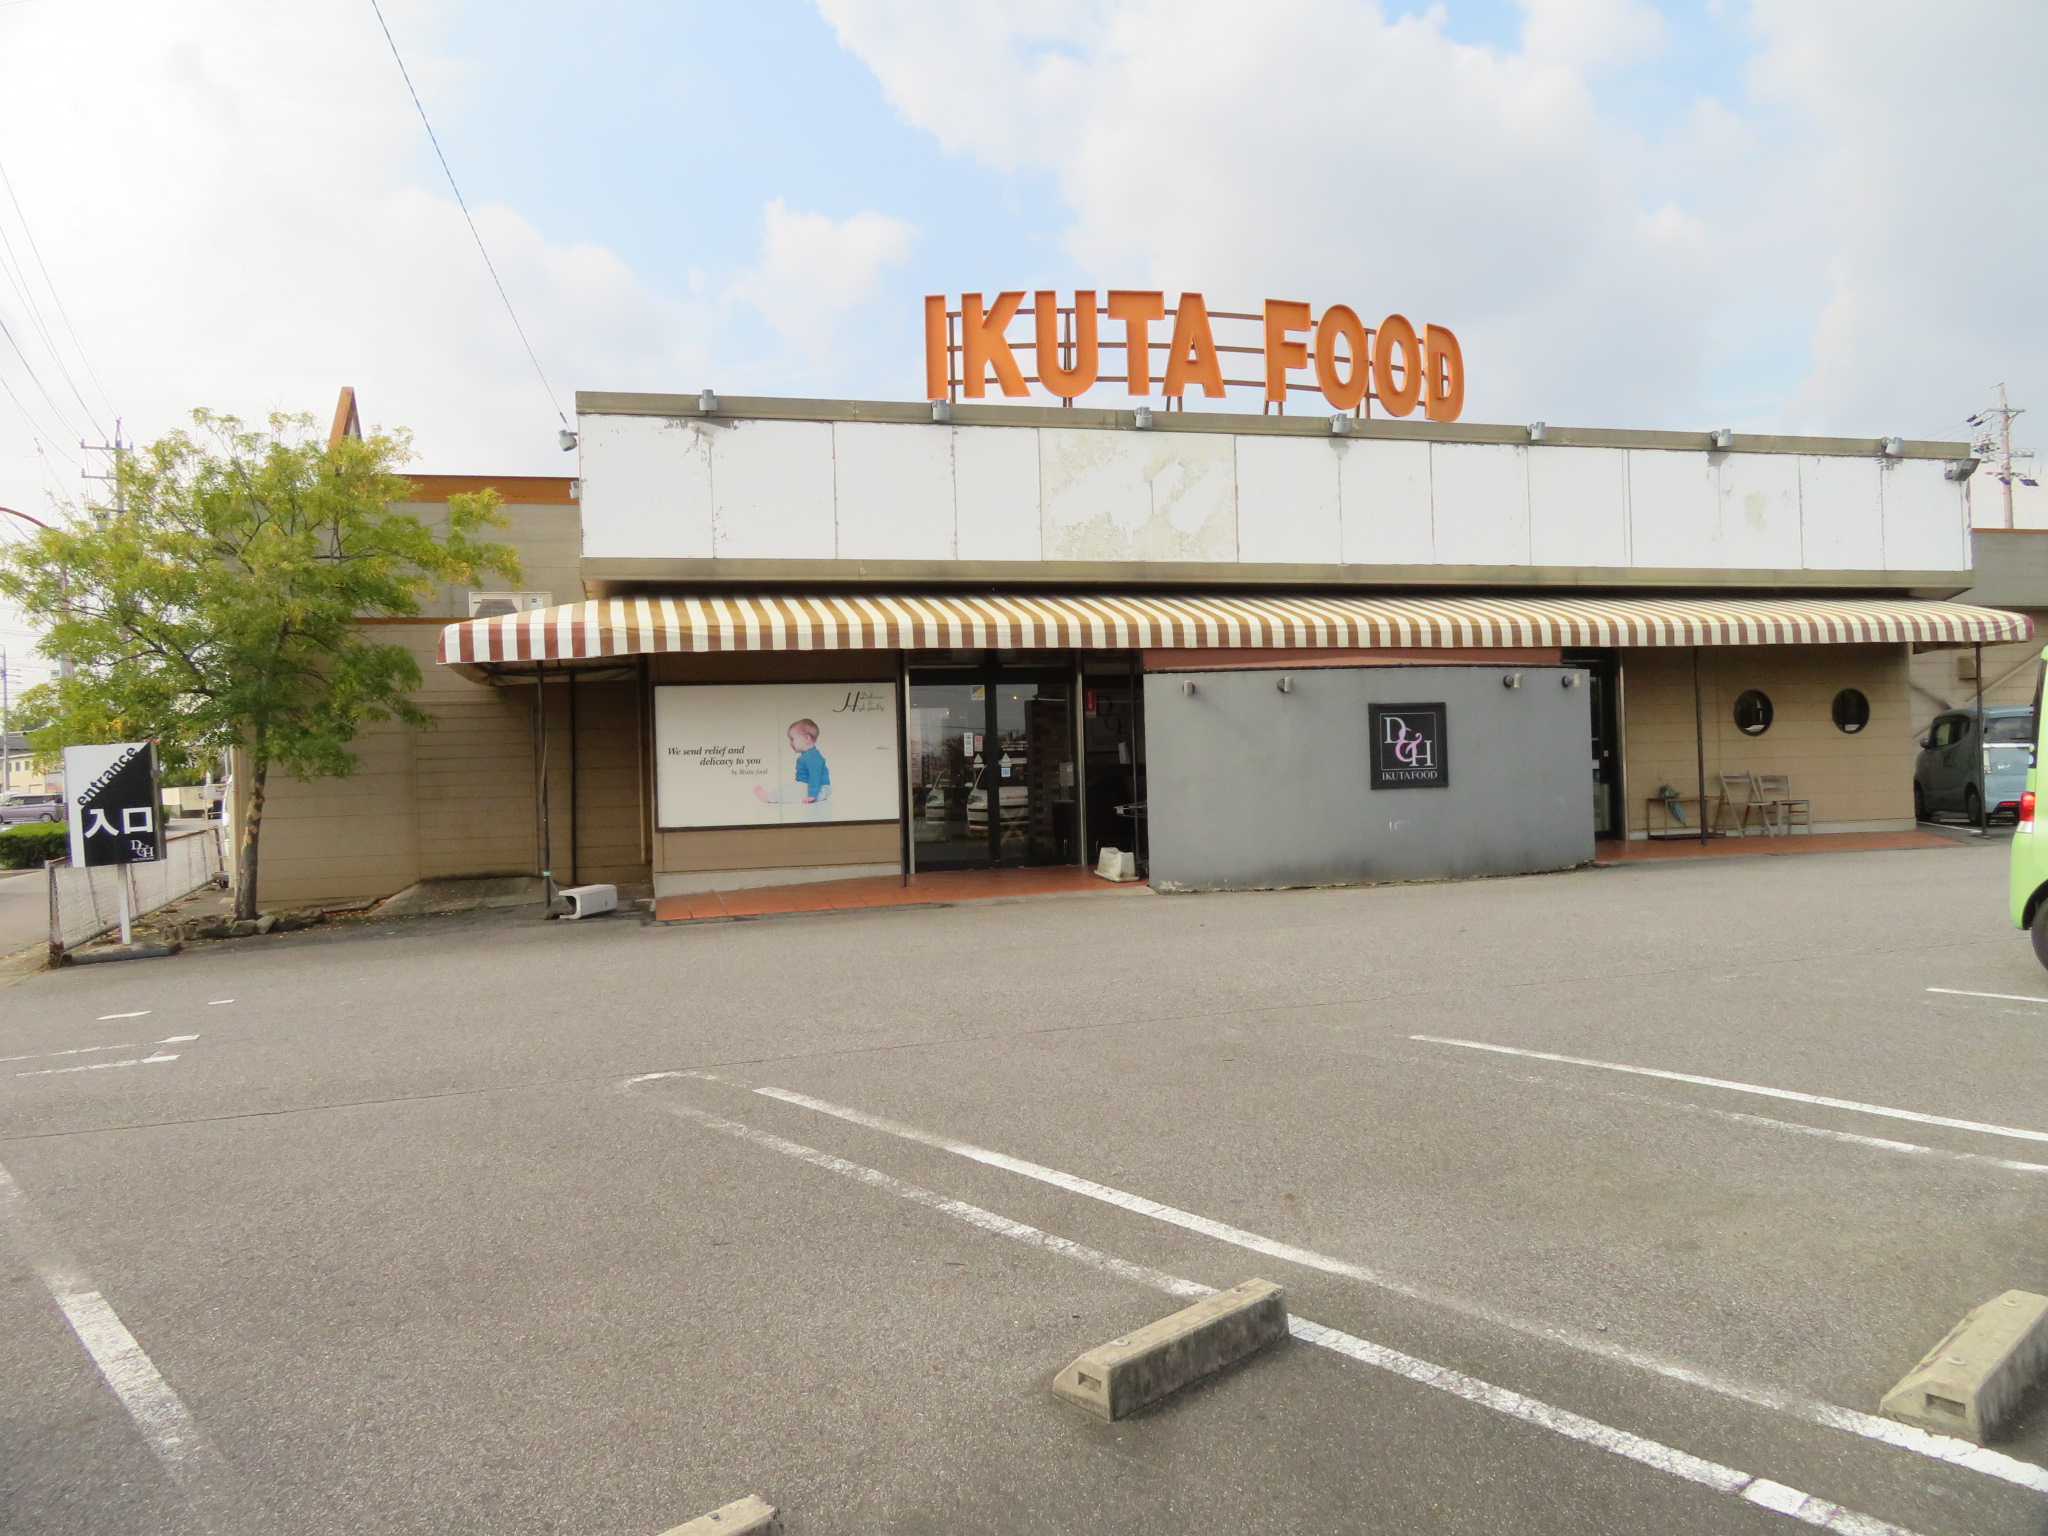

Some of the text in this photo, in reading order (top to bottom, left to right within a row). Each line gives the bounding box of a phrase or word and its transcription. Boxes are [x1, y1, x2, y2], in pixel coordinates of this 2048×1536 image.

[924, 289, 1465, 422] IKUTA FOOD
[668, 746, 745, 757] We send relief and
[1383, 717, 1434, 767] D&H
[77, 746, 138, 806] entrance
[700, 757, 761, 767] delicacy to you
[755, 768, 768, 776] food
[85, 806, 153, 839] 入口
